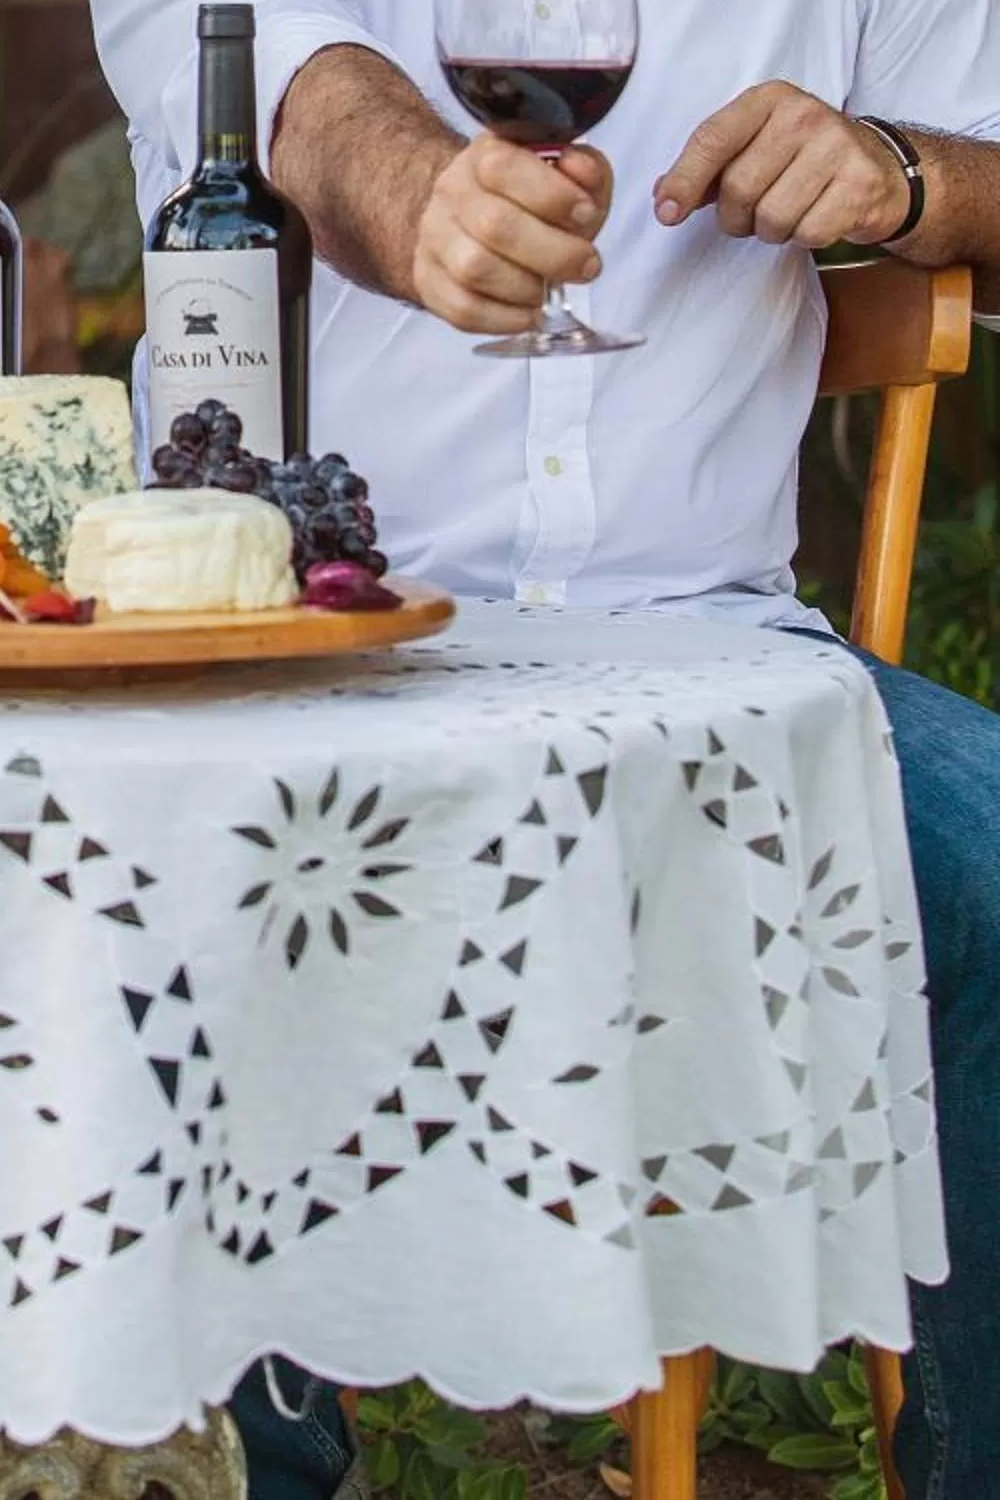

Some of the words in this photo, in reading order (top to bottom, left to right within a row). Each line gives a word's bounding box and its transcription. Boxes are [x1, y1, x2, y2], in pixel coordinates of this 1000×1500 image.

[151, 345, 187, 368] CASA
[192, 352, 212, 368] DI
[217, 345, 269, 367] VINA
